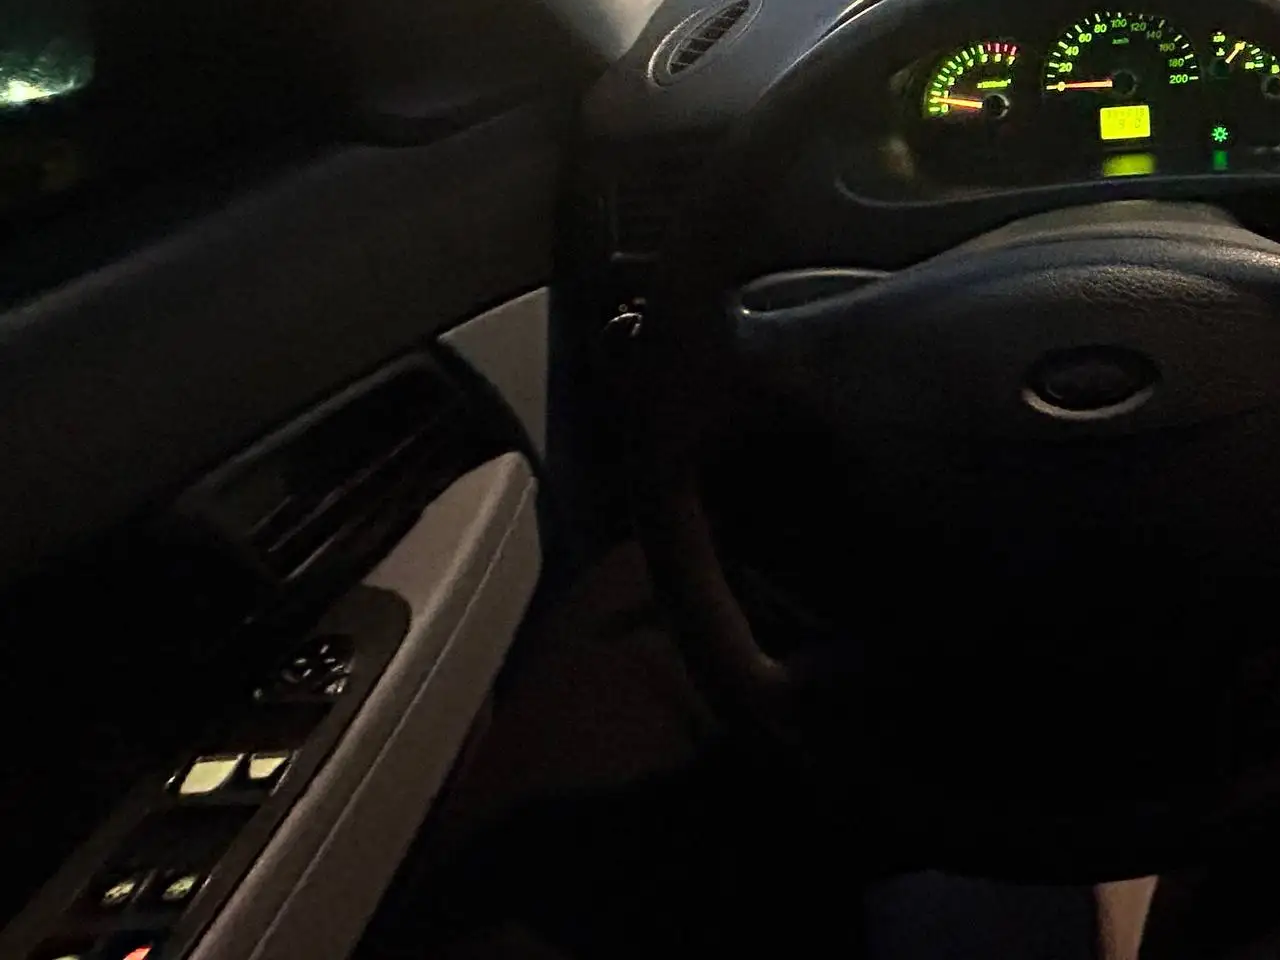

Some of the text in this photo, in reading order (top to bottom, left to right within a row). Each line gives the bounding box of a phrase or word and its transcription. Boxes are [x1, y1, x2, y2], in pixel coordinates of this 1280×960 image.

[1093, 23, 1108, 34] 80
[1130, 21, 1147, 33] 120
[1078, 32, 1093, 44] 60
[1065, 46, 1080, 57] 40
[1058, 62, 1073, 73] 20
[1169, 74, 1189, 85] 200
